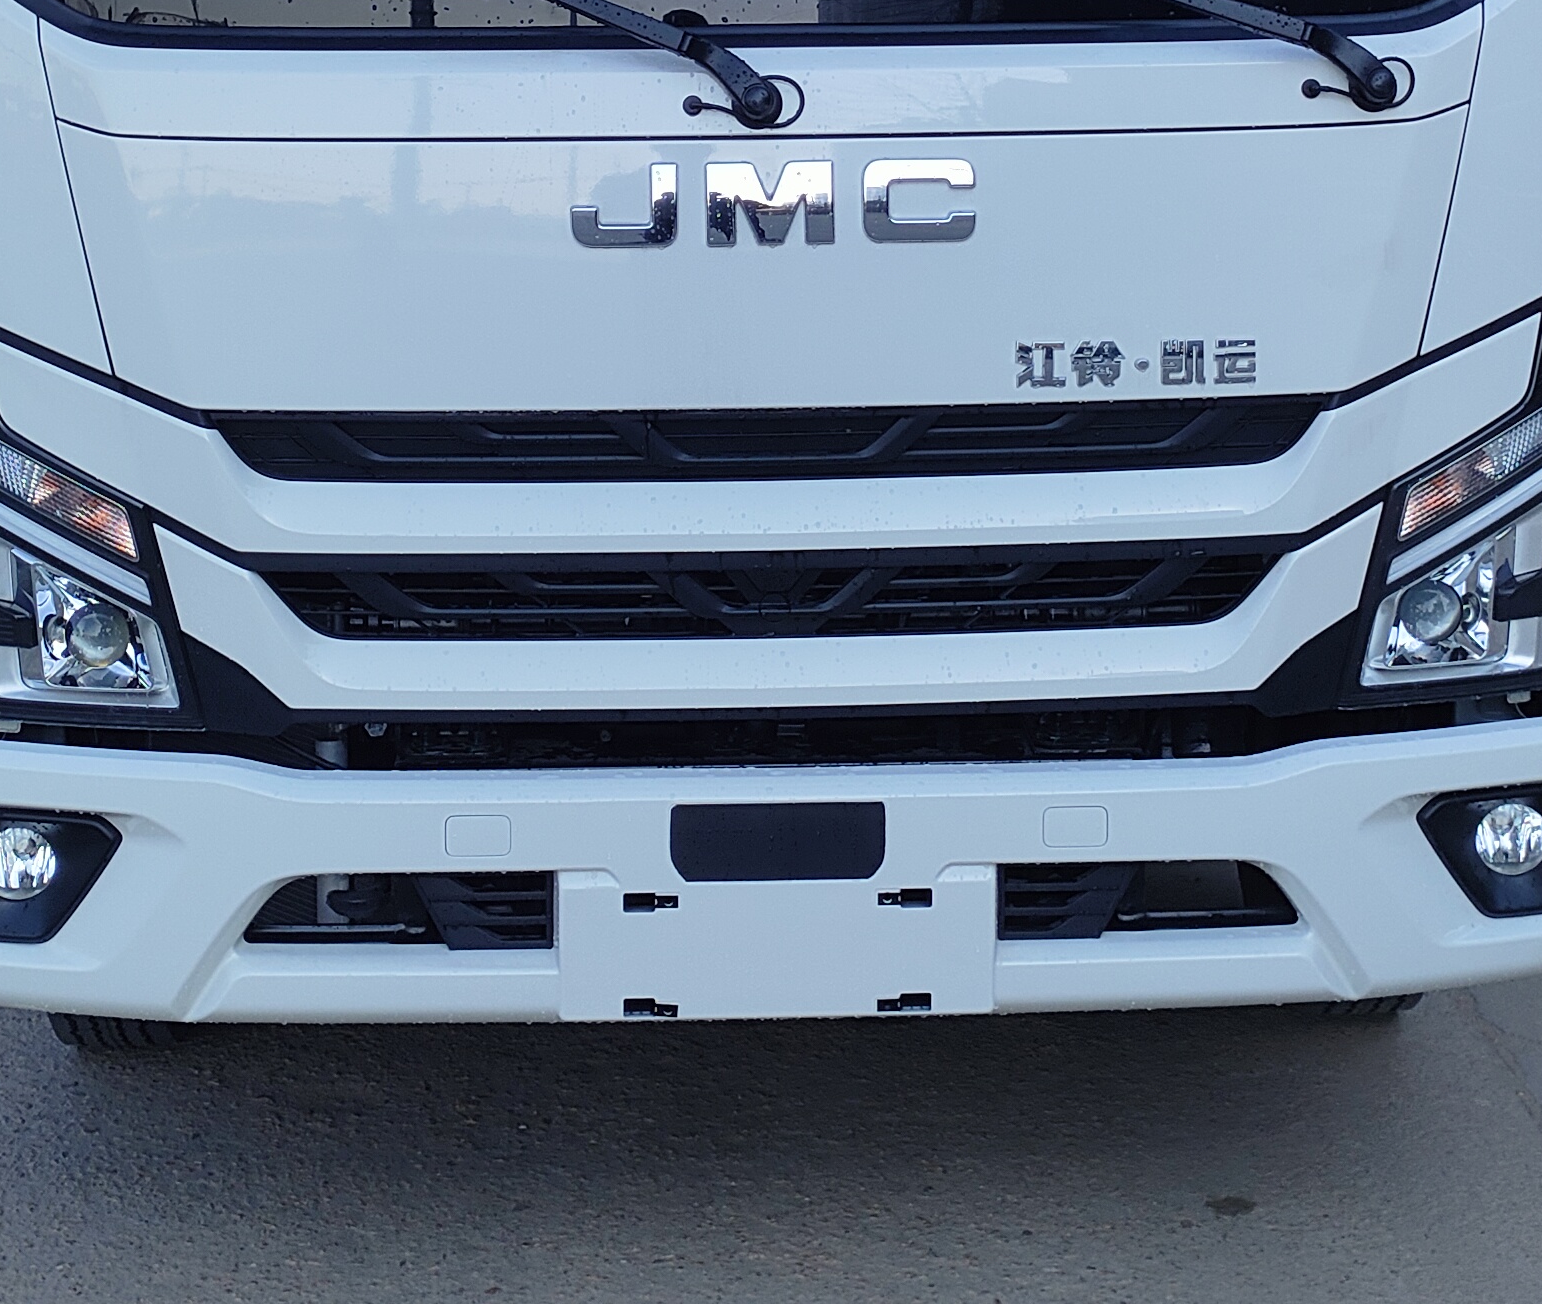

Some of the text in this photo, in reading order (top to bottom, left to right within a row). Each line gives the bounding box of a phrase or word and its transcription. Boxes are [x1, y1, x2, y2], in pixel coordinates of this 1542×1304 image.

[570, 158, 977, 248] JMC
[1014, 338, 1257, 389] 江铃·凯运
